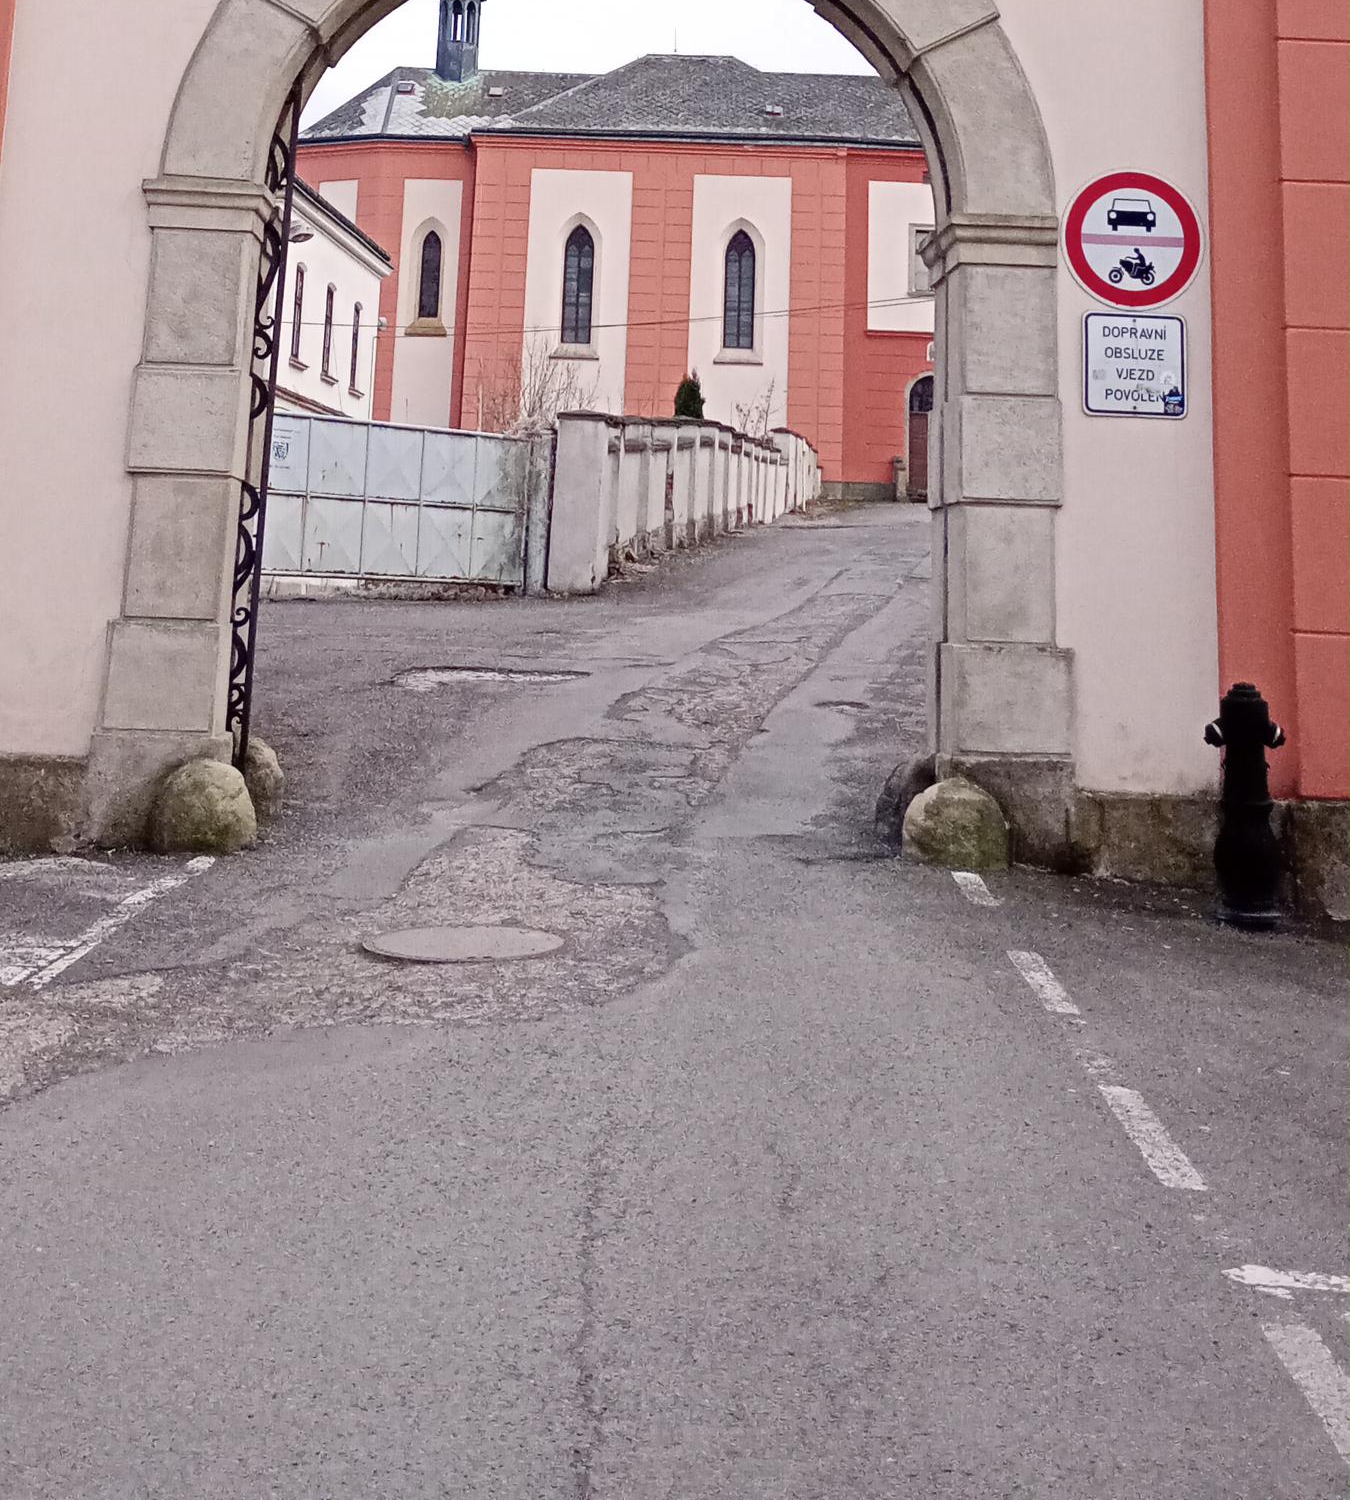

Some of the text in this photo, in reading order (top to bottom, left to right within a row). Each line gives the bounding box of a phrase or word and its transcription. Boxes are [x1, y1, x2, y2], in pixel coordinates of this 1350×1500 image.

[1102, 325, 1167, 340] DOPRAVNÍ
[1104, 346, 1165, 361] OBSLUZE
[1115, 367, 1155, 381] VJEZD
